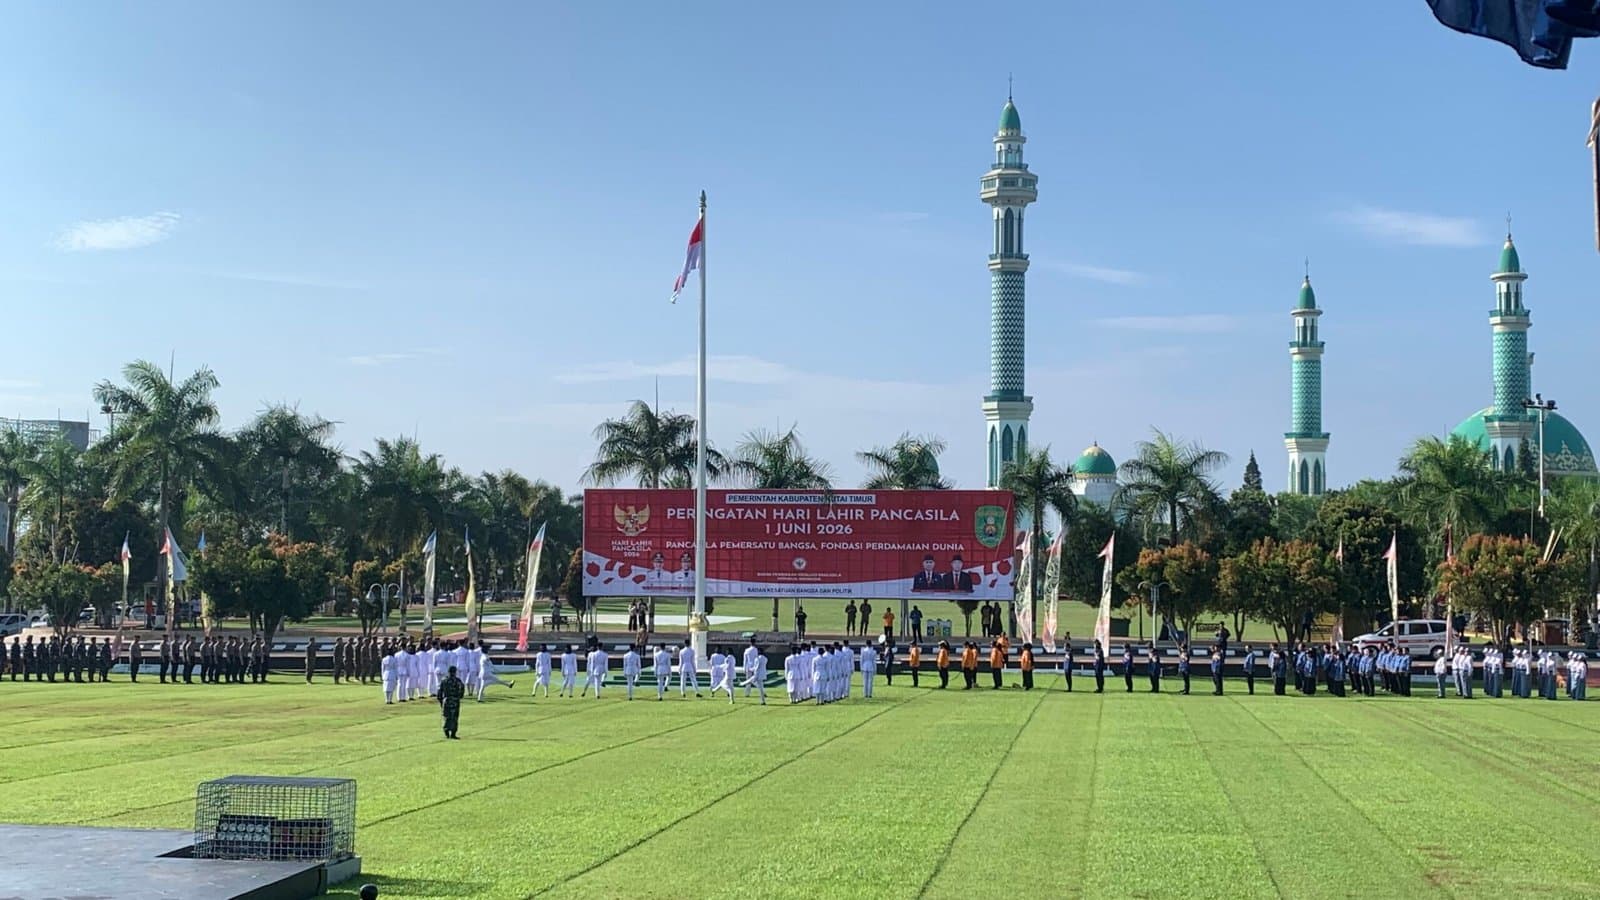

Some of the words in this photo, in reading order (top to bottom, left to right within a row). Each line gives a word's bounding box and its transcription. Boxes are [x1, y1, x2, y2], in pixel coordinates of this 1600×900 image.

[849, 495, 873, 503] TIMUR
[667, 508, 767, 519] PERNGATAN
[773, 508, 810, 520] HARI
[816, 508, 865, 520] LAHIR
[870, 509, 960, 520] PANCASILA
[765, 523, 770, 534] 1
[775, 523, 811, 536] JUNI
[816, 524, 853, 535] 2026
[665, 541, 717, 549] PANCALA
[720, 541, 776, 549] PEMERSATU
[778, 542, 819, 550] BANGSA,
[821, 542, 863, 550] FONDASI
[932, 543, 965, 551] DUNIA
